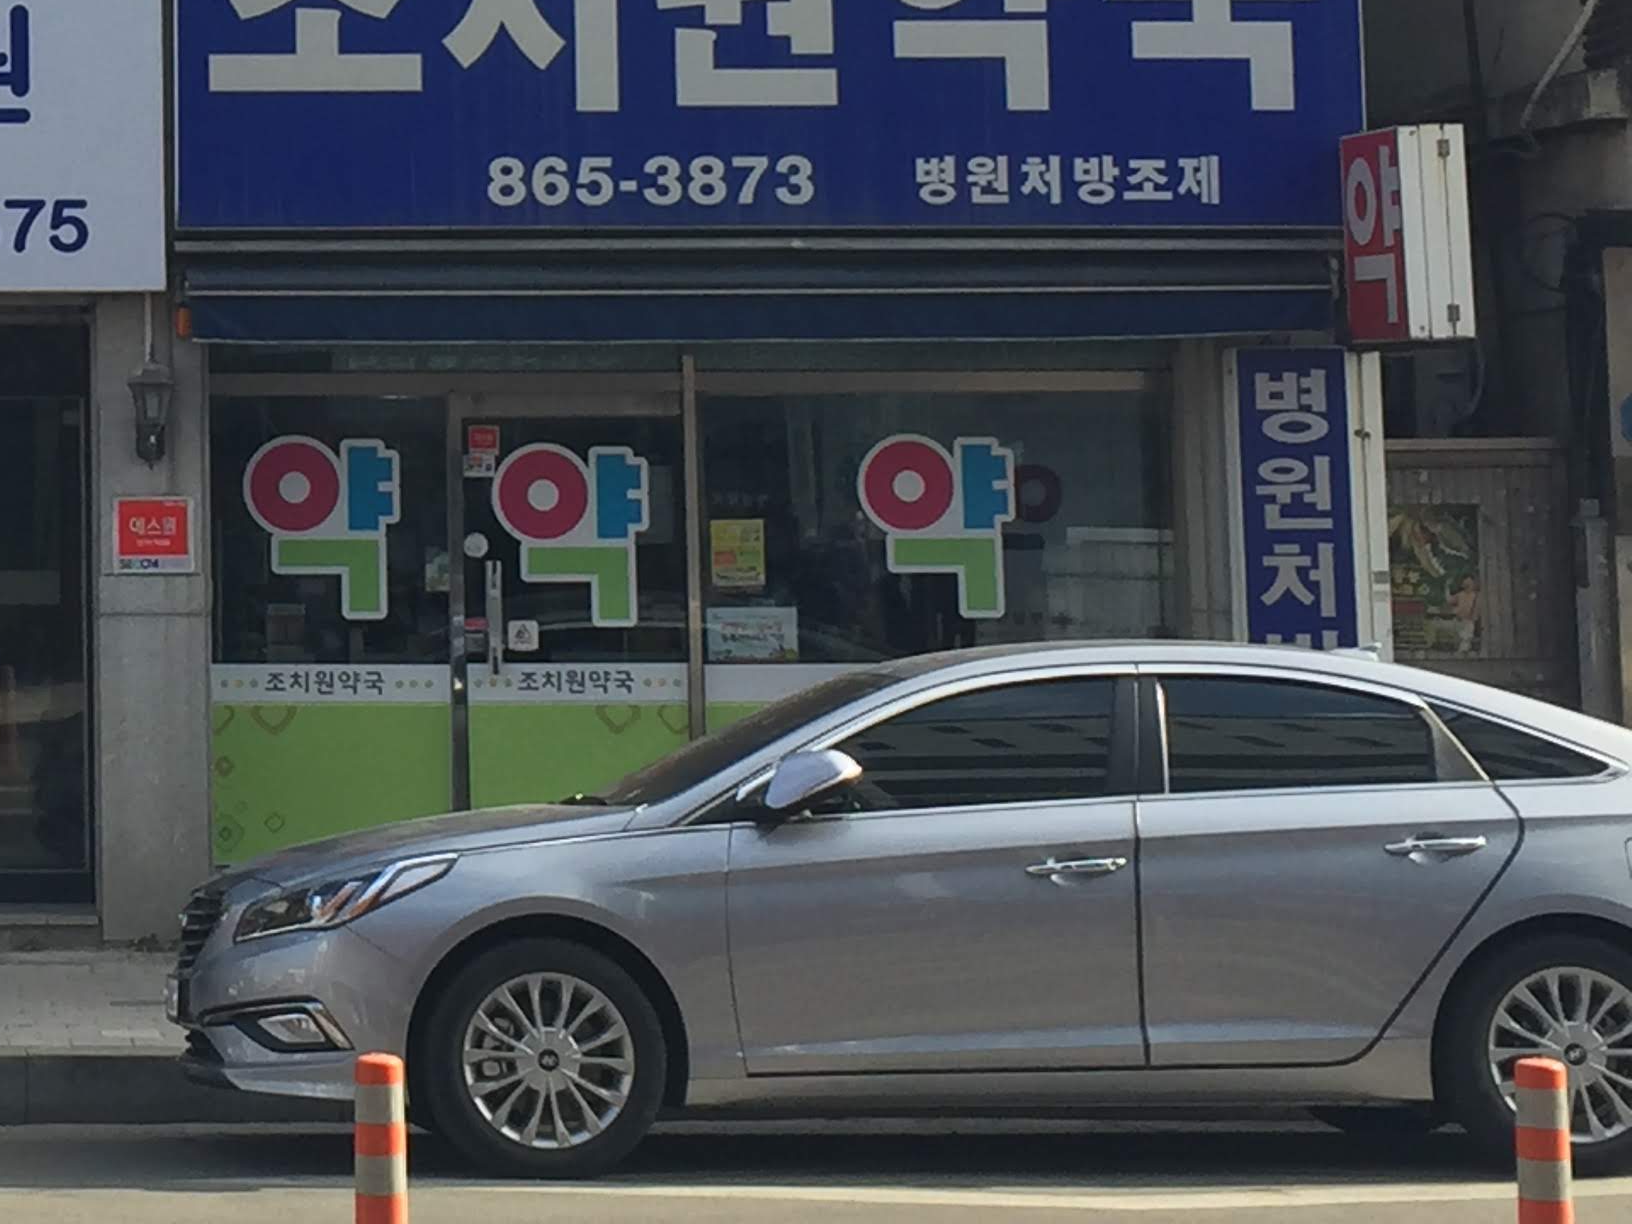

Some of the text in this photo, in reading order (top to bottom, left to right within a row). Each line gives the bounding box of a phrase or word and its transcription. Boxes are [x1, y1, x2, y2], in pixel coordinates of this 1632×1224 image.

[487, 155, 1221, 206] 865-3873 병원처방조제
[1345, 145, 1402, 324] 약
[244, 435, 400, 620] 약
[492, 443, 649, 628] 약
[857, 433, 1016, 619] 약
[1254, 368, 1340, 650] 병원처
[265, 670, 386, 694] 조치원약국
[517, 669, 636, 694] 조치원약국
